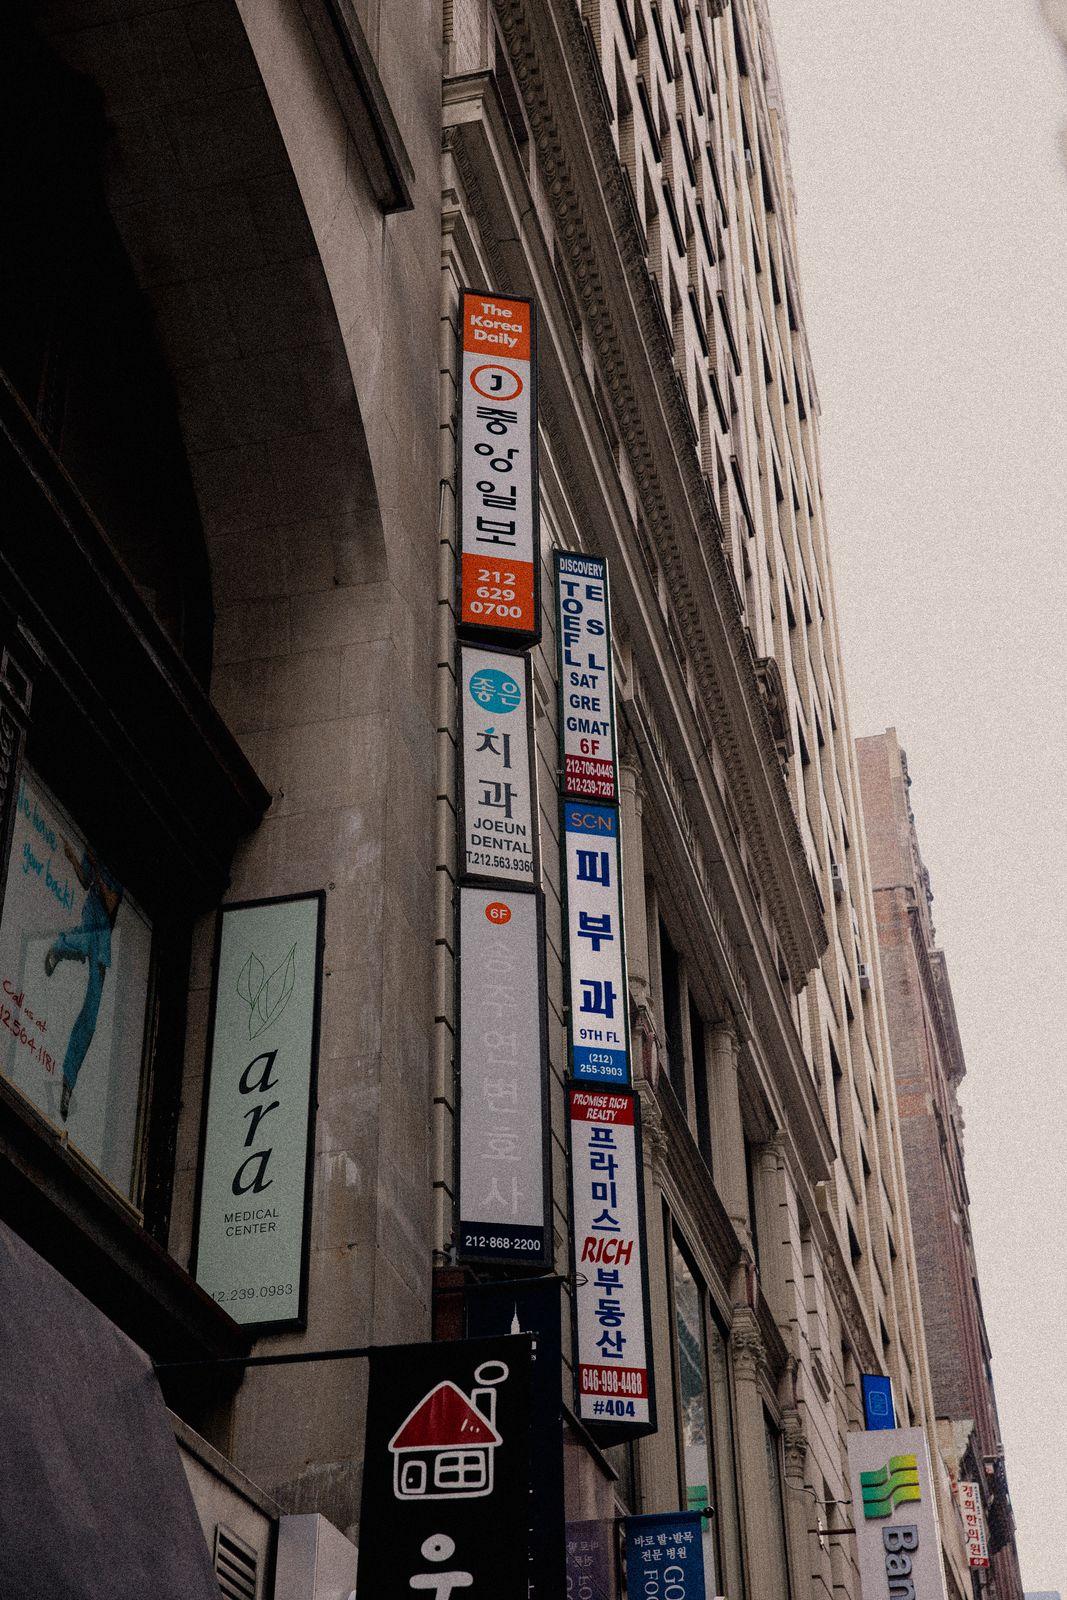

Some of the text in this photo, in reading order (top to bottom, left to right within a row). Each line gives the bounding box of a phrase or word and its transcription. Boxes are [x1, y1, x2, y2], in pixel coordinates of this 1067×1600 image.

[481, 302, 513, 318] The
[470, 315, 523, 334] Korea
[474, 329, 517, 348] Daily
[490, 374, 503, 391] J
[474, 406, 519, 546] 중앙일보
[477, 569, 516, 585] 212
[559, 558, 603, 578] DISCOVERY
[476, 585, 515, 602] 629
[470, 600, 522, 619] 0700
[561, 580, 584, 667] TOEFL
[585, 585, 605, 671] ESL
[570, 672, 598, 689] SAT
[472, 677, 521, 707] 좋은
[569, 694, 601, 712] GRE
[567, 716, 609, 736] GMAT
[580, 738, 600, 755] 6F
[475, 727, 518, 819] 치과
[473, 817, 526, 836] JOEUN
[471, 833, 532, 854] DENTAL
[466, 850, 534, 873] T.212.563.9360
[490, 907, 508, 919] 6F
[576, 849, 617, 1019] 피부과
[2, 979, 25, 1008] Call
[579, 1028, 620, 1043] 9TH FL
[589, 1053, 613, 1065] (212)
[580, 1064, 623, 1076] 255-3903
[573, 1093, 628, 1110] PROMISE RICH
[586, 1107, 618, 1121] REALTY
[588, 1126, 621, 1233] 프라미스
[224, 1208, 279, 1224] MEDICAL
[225, 1221, 276, 1237] CENTER
[581, 1235, 634, 1266] RICH
[594, 1268, 627, 1359] 부동산
[582, 1368, 643, 1395] 646-998-4488
[593, 1400, 636, 1417] #404
[633, 1535, 656, 1548] 바로
[641, 1547, 688, 1562] 전문 병원
